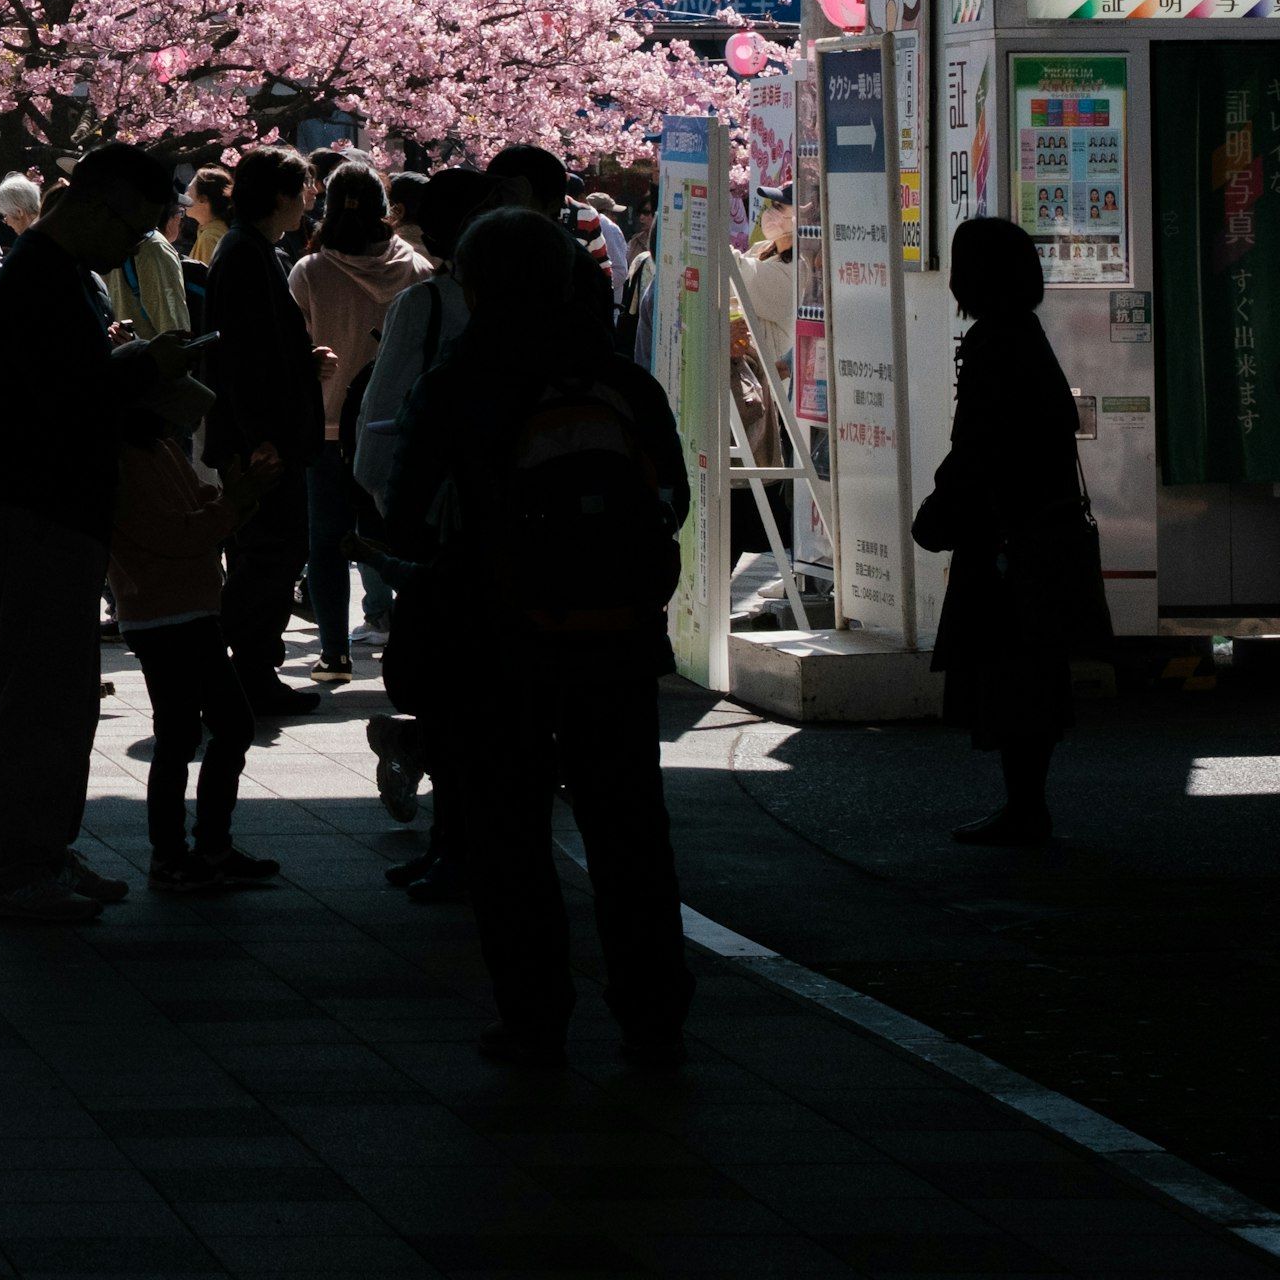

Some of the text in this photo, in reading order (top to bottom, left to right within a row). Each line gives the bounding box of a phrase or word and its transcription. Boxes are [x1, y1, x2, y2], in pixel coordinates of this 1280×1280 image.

[828, 73, 881, 102] タクシー乗り場
[1224, 89, 1257, 245] 証明写真
[1231, 268, 1257, 436] すぐ出来ます
